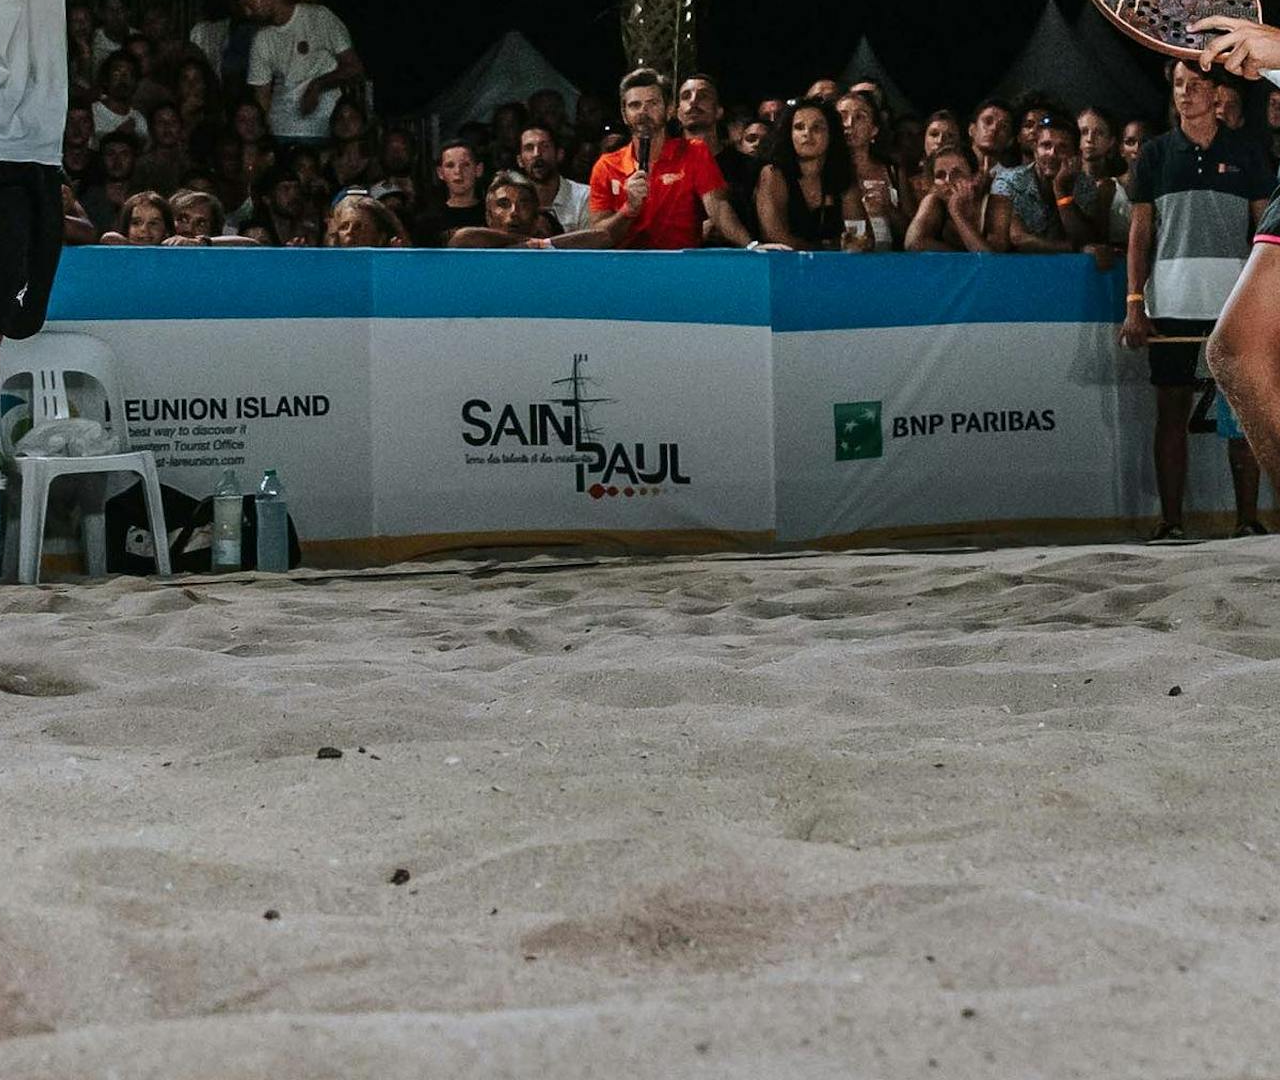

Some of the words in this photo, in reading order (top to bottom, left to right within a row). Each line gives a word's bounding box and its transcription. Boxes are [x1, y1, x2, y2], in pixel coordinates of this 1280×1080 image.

[236, 395, 330, 420] ISLAND
[892, 415, 944, 438] BNP
[951, 409, 1056, 435] PARIBAS
[155, 454, 246, 468] st-lereunion.com
[575, 442, 692, 493] PAUL
